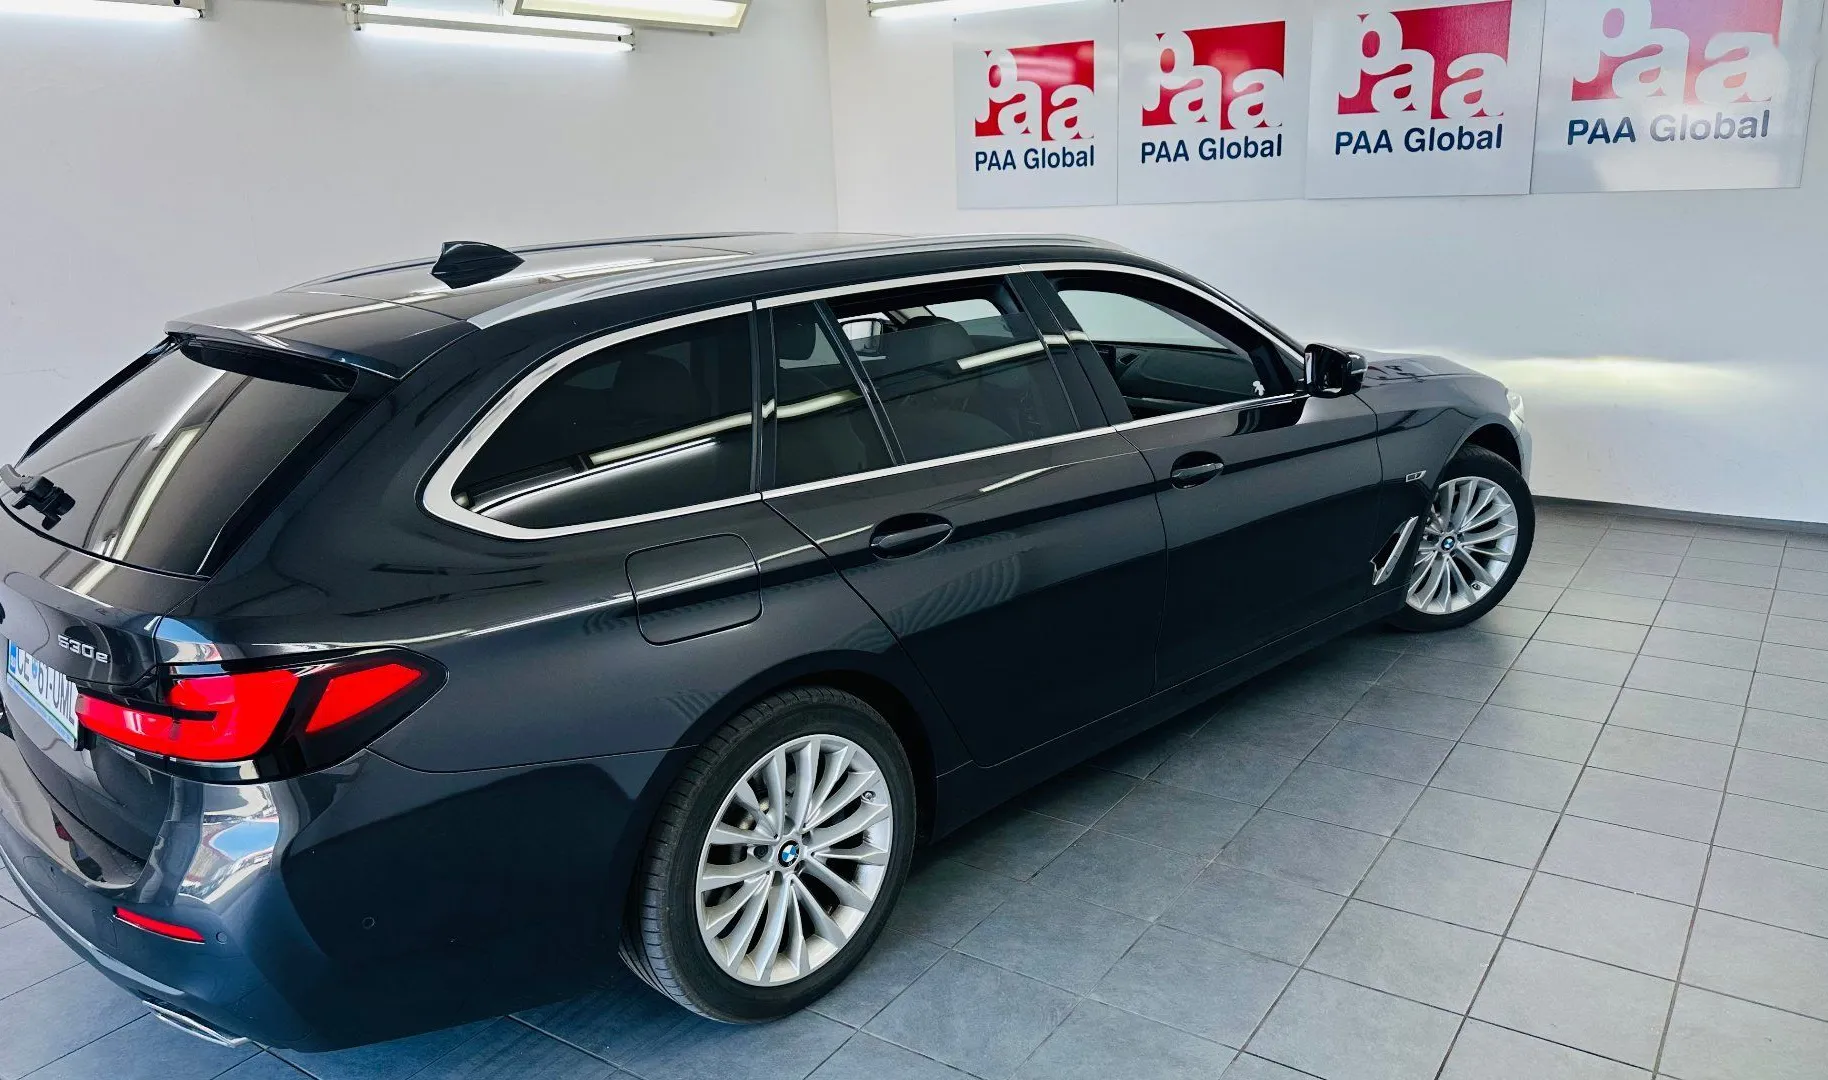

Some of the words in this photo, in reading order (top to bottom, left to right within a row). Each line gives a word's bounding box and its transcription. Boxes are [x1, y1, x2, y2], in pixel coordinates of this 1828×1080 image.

[1334, 129, 1394, 155] PAA
[1403, 123, 1503, 152] Global
[1567, 117, 1637, 146] PAA
[1649, 110, 1771, 142] Global
[974, 149, 1017, 172] PAA
[1023, 145, 1095, 170] Global
[1140, 139, 1190, 164] PAA
[1198, 134, 1283, 161] Global
[57, 634, 110, 664] 530e
